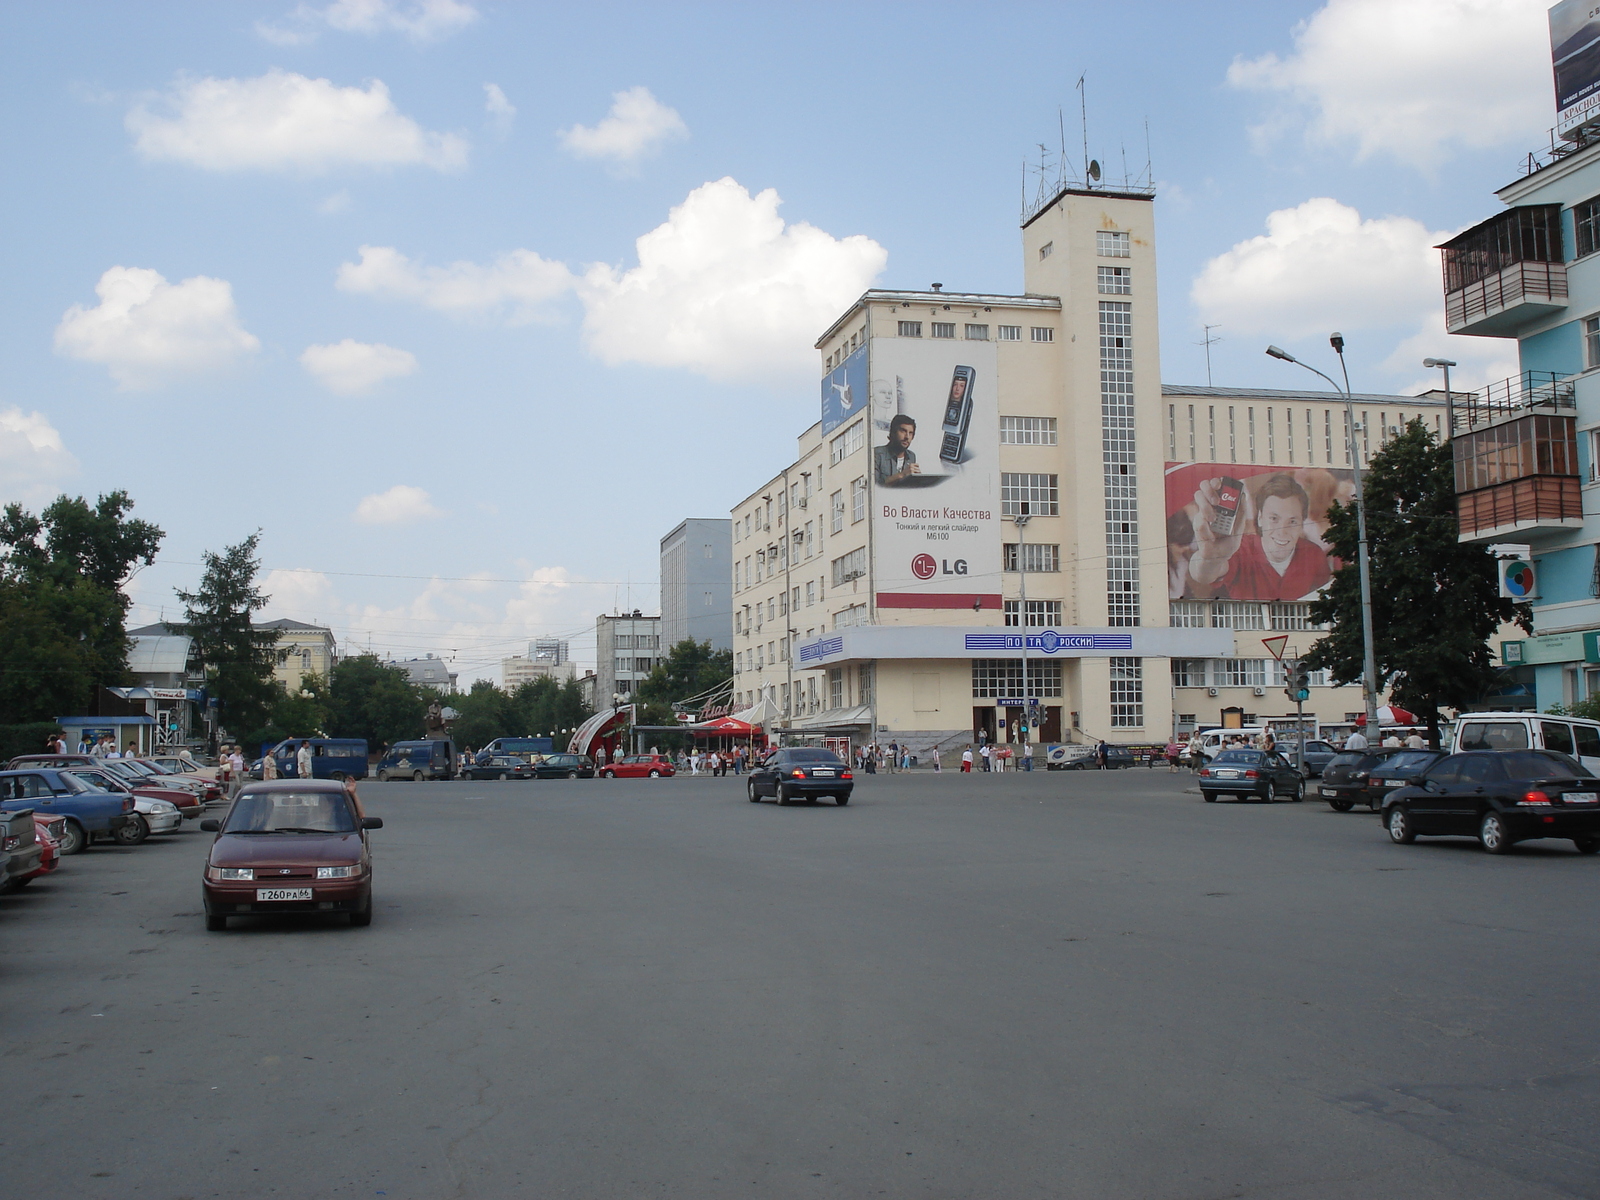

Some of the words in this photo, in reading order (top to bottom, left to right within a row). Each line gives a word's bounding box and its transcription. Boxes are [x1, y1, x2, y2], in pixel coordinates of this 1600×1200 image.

[883, 505, 897, 518] Во
[901, 505, 939, 519] Власти
[943, 507, 991, 520] Качества
[895, 522, 919, 531] Тонкий
[927, 523, 950, 532] легкий
[951, 523, 979, 533] слайдер
[926, 532, 949, 540] M6100
[942, 559, 968, 575] LG
[1007, 637, 1042, 647] ПОТА
[1060, 637, 1092, 647] РОССИИ
